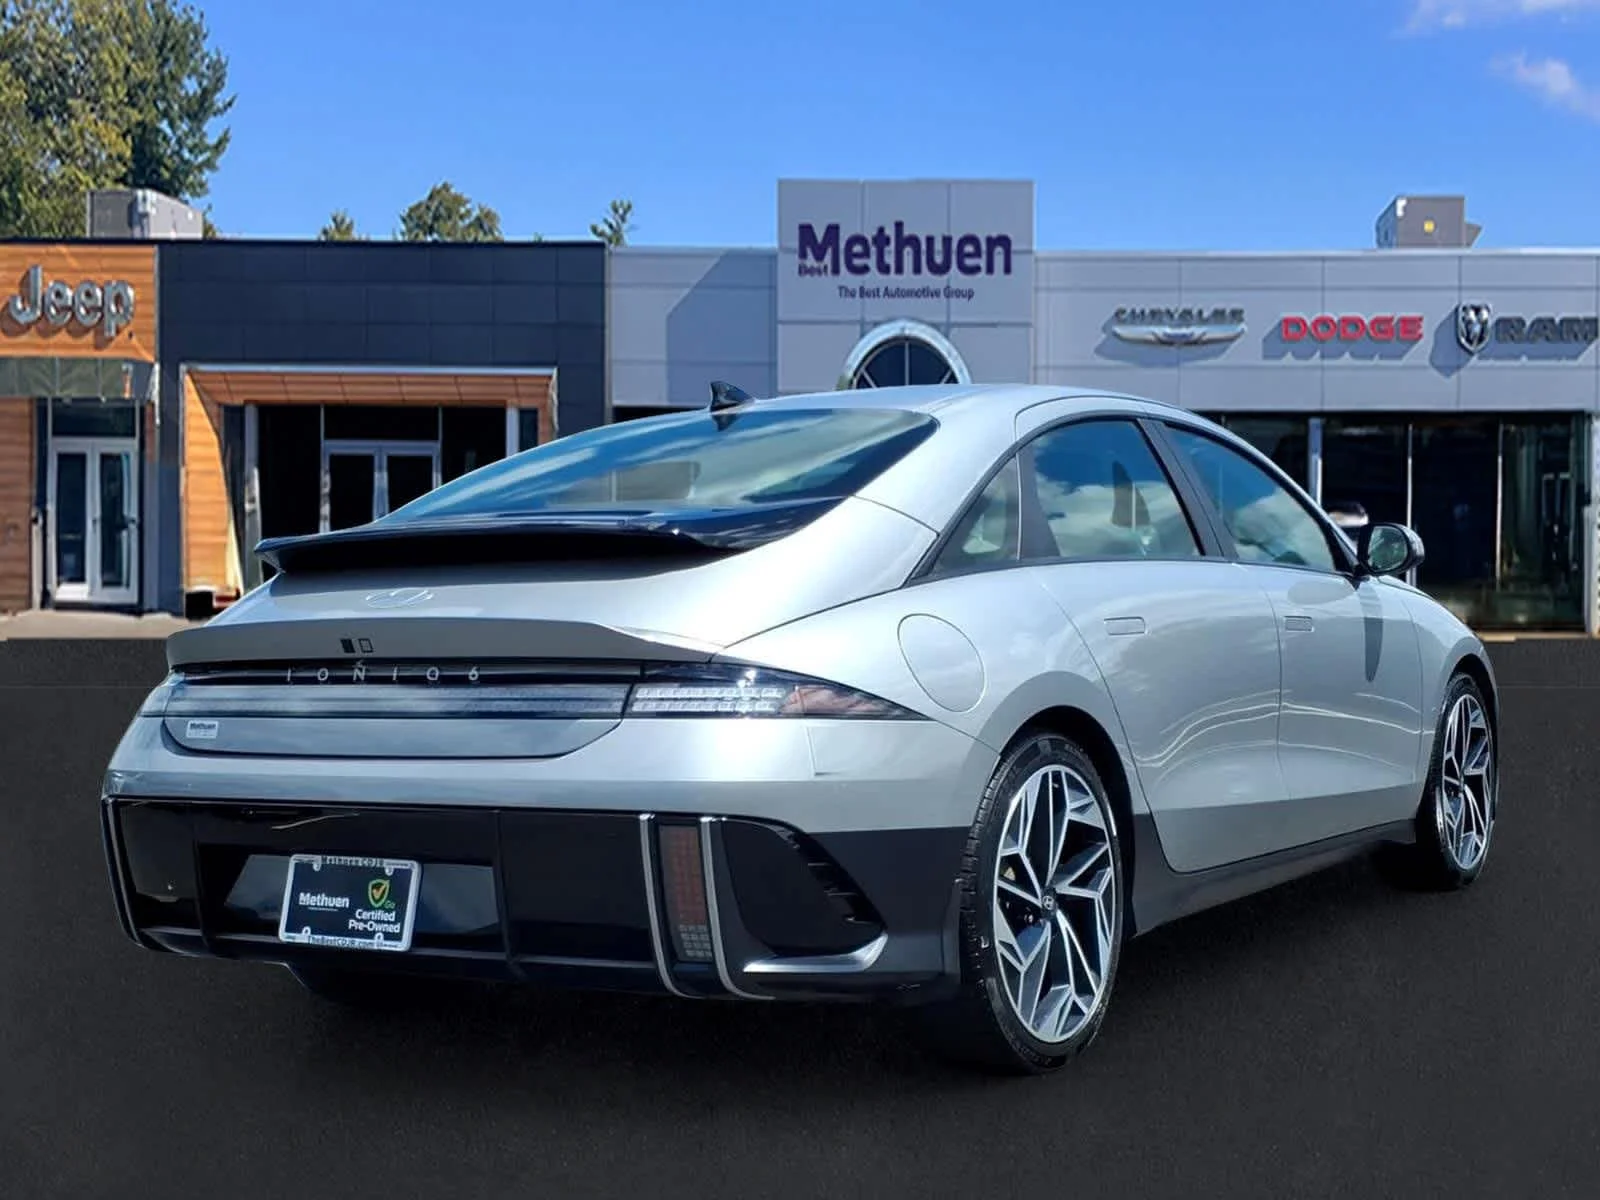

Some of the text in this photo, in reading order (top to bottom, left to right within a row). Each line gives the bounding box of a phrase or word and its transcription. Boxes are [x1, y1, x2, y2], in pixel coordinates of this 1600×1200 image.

[798, 220, 1013, 277] Methuen
[8, 263, 136, 338] Jeep
[838, 286, 975, 301] The Best Automotive Group
[1114, 307, 1245, 323] CHRYSLER
[1281, 315, 1424, 341] DODGE
[1495, 315, 1599, 343] RAM
[467, 666, 480, 682] 6
[298, 892, 350, 908] Methuen
[355, 908, 396, 922] Certified
[348, 919, 401, 933] Pre-Owned
